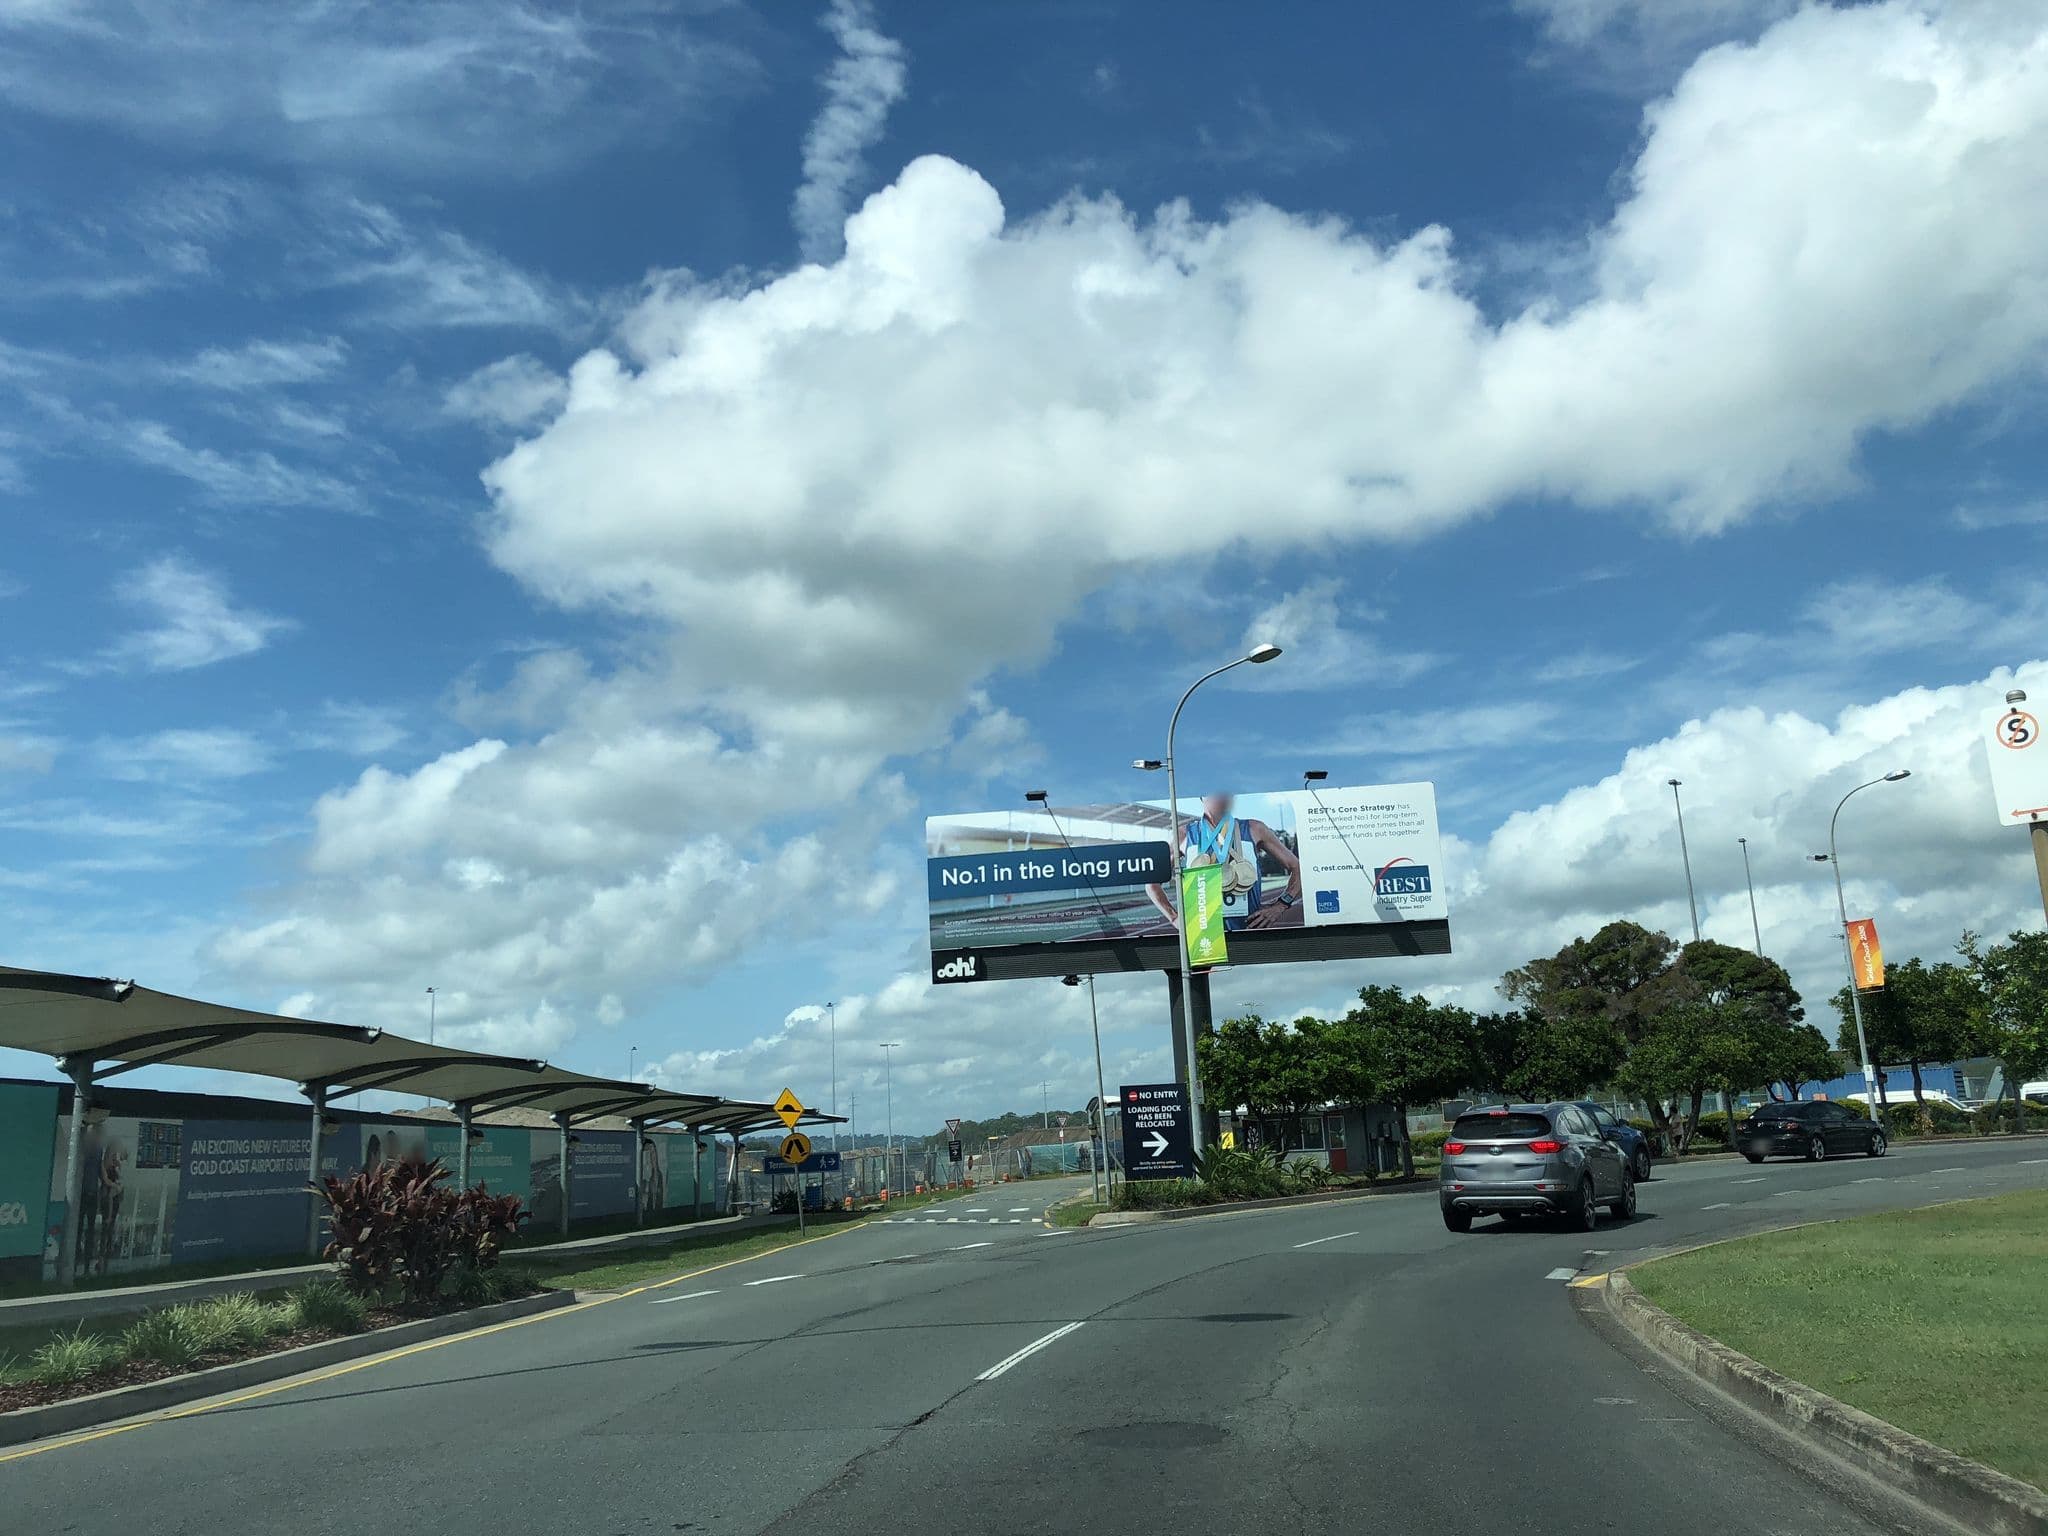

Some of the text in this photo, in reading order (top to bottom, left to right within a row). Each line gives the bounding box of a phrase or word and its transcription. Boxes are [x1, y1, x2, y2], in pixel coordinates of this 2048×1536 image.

[1360, 804, 1395, 812] Strategy
[1309, 815, 1327, 823] been
[1370, 812, 1380, 820] for
[1352, 831, 1373, 839] funds
[942, 856, 1154, 886] No.1 in the long run
[1321, 864, 1364, 872] rest.com.au
[1380, 877, 1428, 893] REST
[1377, 894, 1432, 905] Industry Super
[1136, 1120, 1175, 1128] RELOCATED
[191, 1138, 312, 1155] AN EXCITING NEW FUTURE FO
[190, 1159, 218, 1176] GOLD
[218, 1158, 250, 1175] COAST
[250, 1157, 285, 1173] AIRPORT
[285, 1157, 294, 1172] IS
